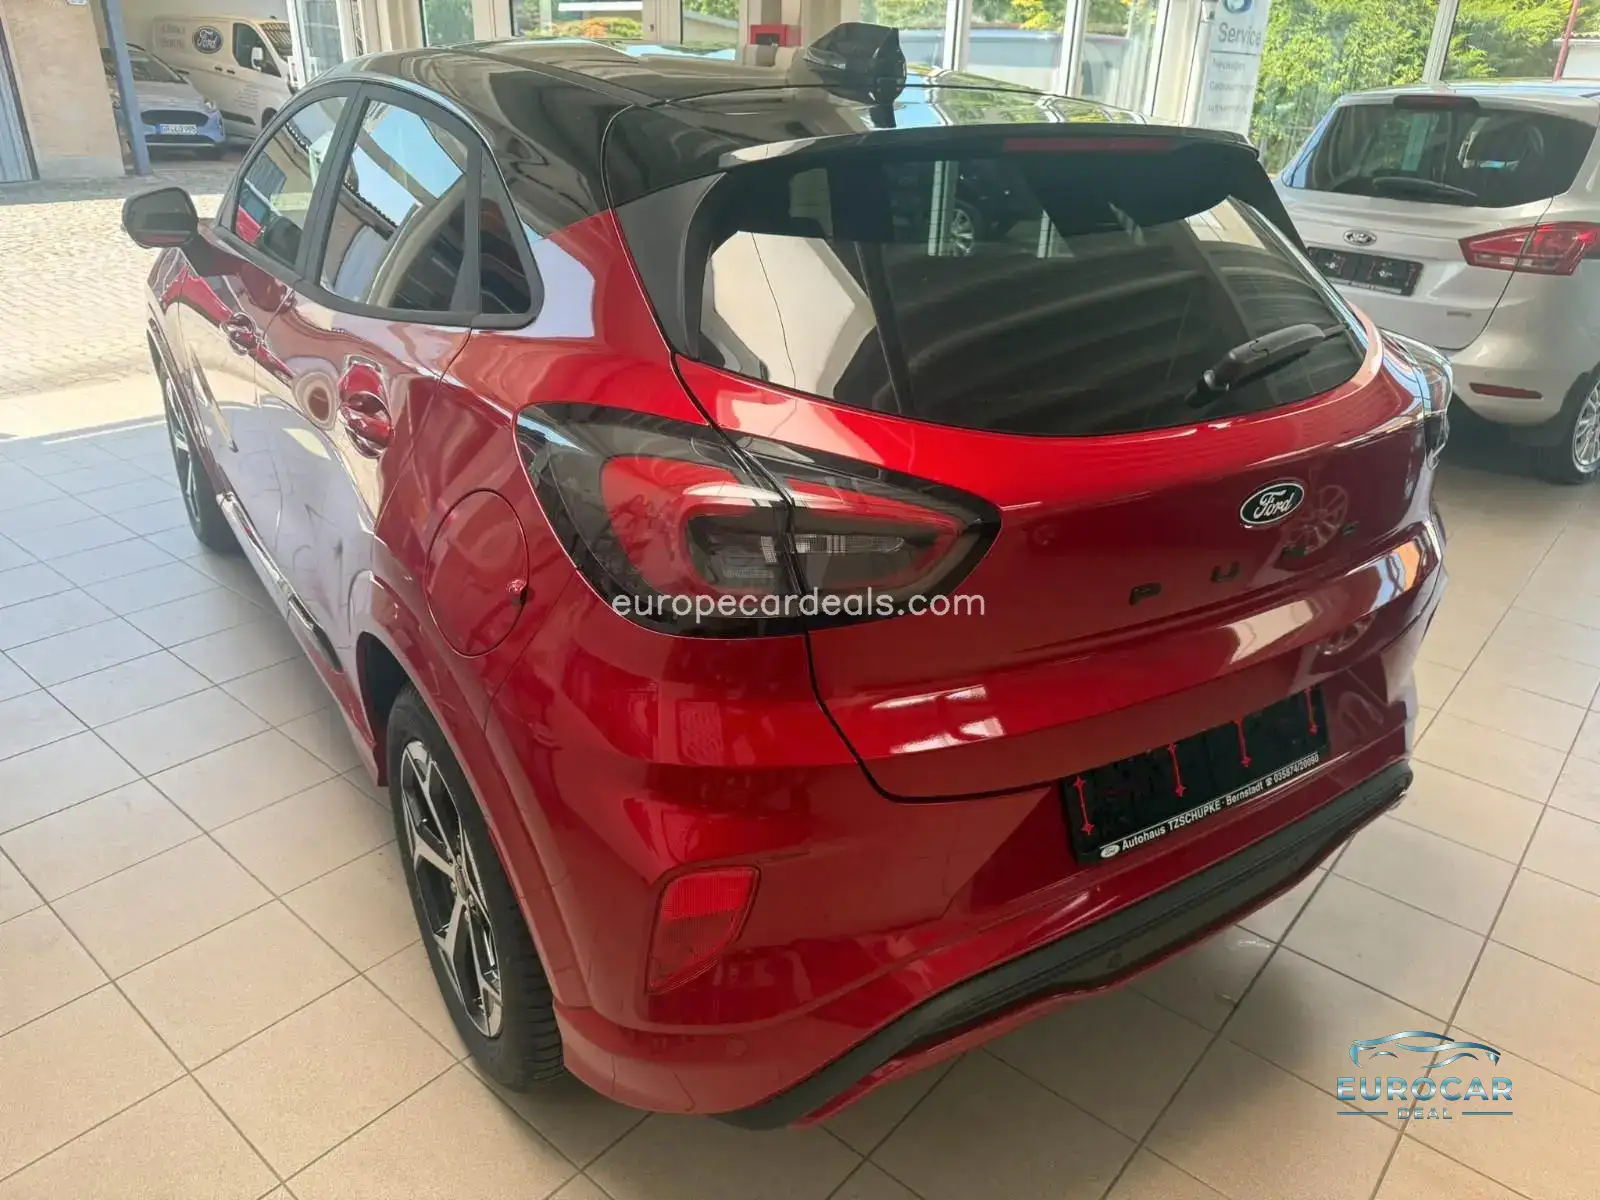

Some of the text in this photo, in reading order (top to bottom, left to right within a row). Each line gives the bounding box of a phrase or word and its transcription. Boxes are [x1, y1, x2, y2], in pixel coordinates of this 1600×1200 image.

[1218, 22, 1262, 46] Service
[1253, 490, 1293, 519] Ford
[1122, 826, 1166, 851] Autohaus
[1167, 799, 1221, 831] TZSCHUPKE
[1226, 781, 1264, 806] Bernstadt
